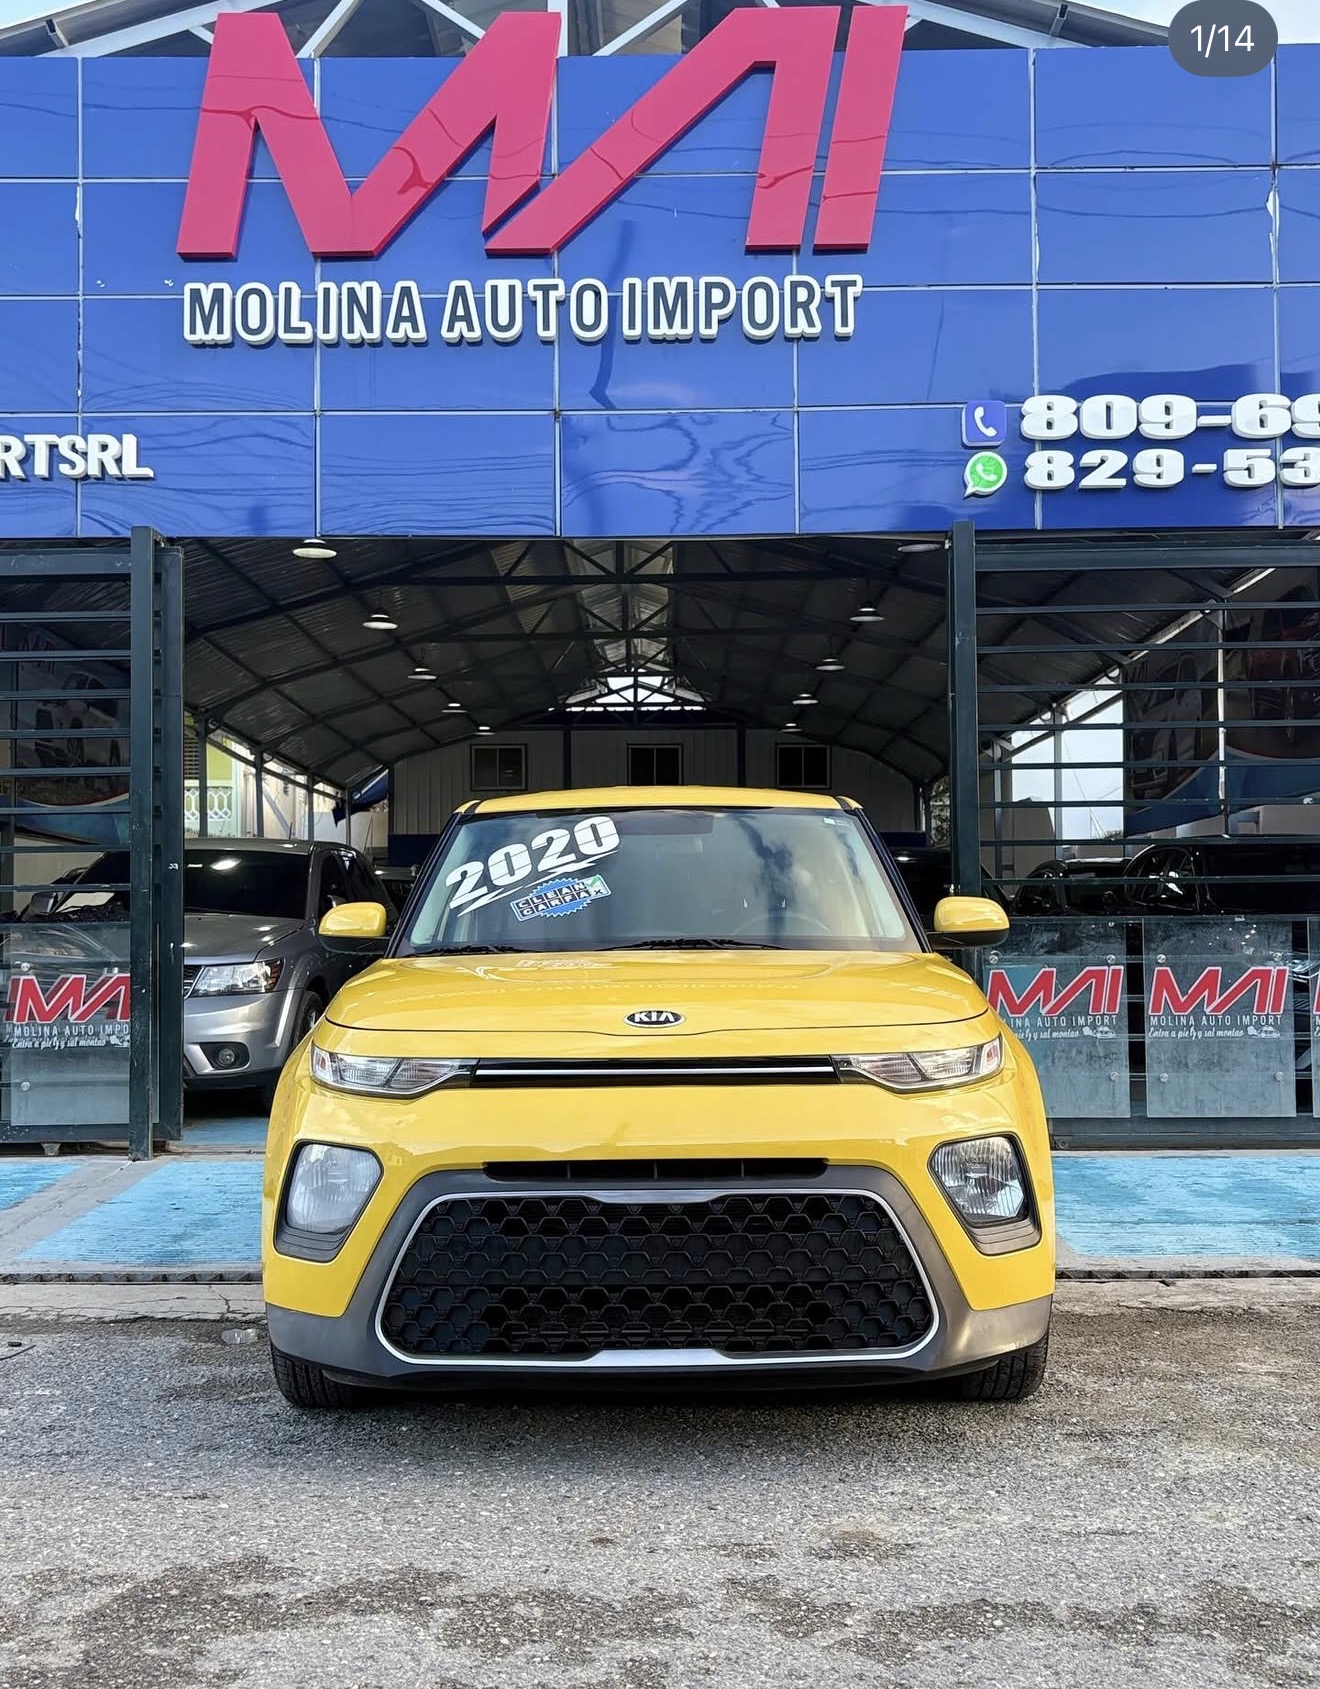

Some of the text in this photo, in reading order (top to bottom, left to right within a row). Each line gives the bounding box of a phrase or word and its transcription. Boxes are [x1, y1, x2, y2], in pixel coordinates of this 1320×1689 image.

[176, 5, 908, 260] MAI
[183, 274, 863, 344] MOLINA AUTO IMPORT
[1024, 446, 1320, 490] 829-53
[445, 816, 620, 909] 2020
[516, 882, 587, 909] CLEAN
[521, 887, 604, 917] CARFAX
[987, 965, 1124, 1017] MAI
[1149, 966, 1289, 1015] MAI
[14, 1025, 58, 1037] MOLINA
[64, 1025, 94, 1036] AUTO
[634, 1011, 676, 1023] KIA
[1004, 1015, 1117, 1028] INA AUTO IMPORT
[1150, 1015, 1282, 1026] MOLINA AUTO IMPORT
[1040, 1028, 1051, 1039] sal
[1149, 1027, 1169, 1038] Entra
[1204, 1027, 1216, 1038] sal
